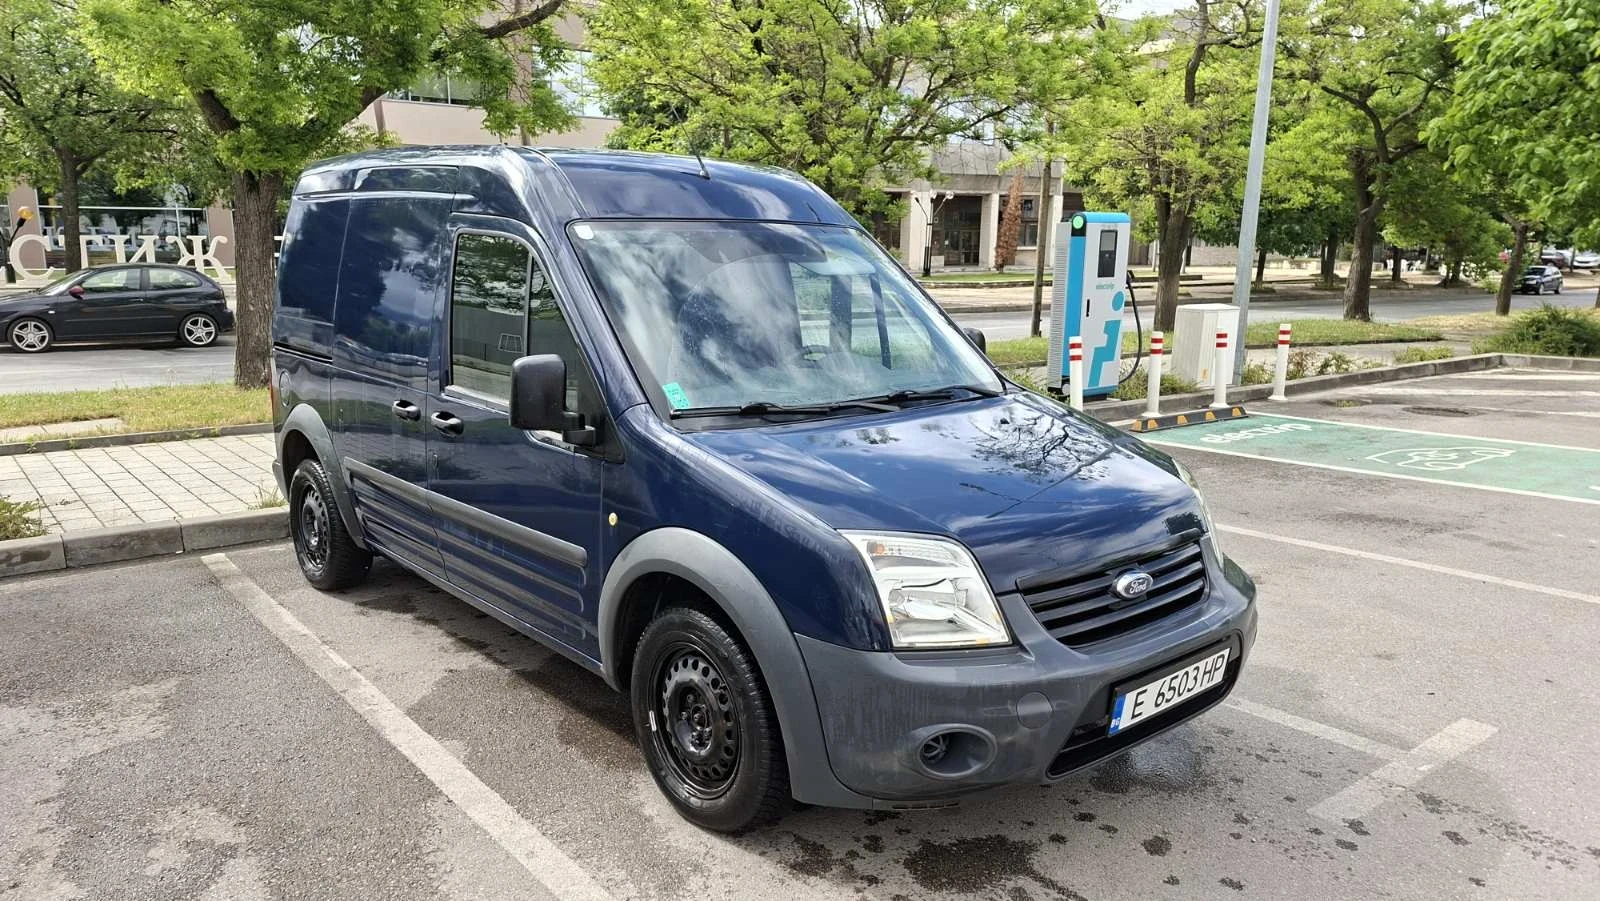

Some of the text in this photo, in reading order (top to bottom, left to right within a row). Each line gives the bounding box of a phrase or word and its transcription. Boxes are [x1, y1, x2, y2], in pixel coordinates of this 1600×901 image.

[1130, 653, 1225, 720] E 6503 HP
